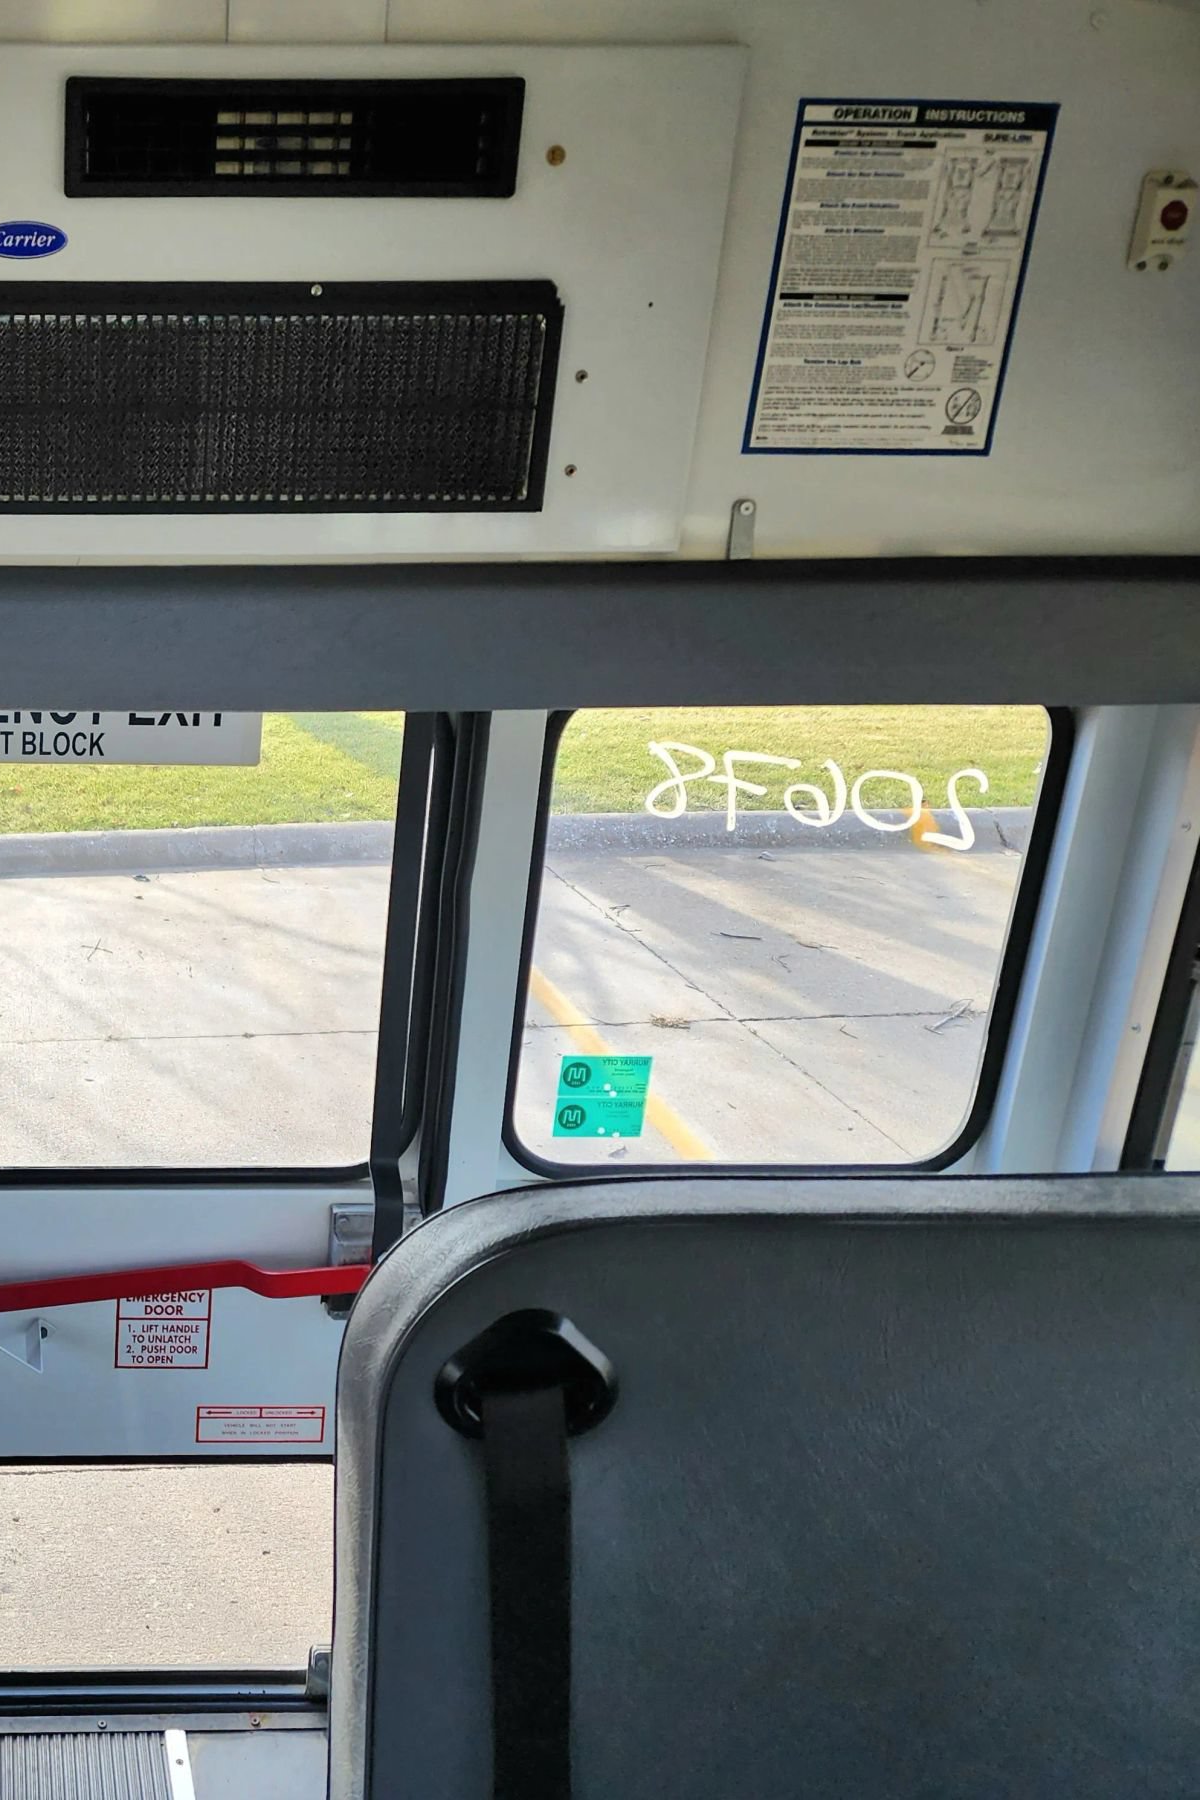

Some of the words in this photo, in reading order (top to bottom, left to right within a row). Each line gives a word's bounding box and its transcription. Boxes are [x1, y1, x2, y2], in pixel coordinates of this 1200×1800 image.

[833, 107, 913, 121] OPERATION
[925, 109, 1026, 123] INSTRUCTIONS
[21, 732, 105, 757] BLOCK
[144, 1304, 184, 1316] DOOR
[127, 1324, 136, 1334] 1.
[141, 1324, 159, 1334] LIFT
[162, 1324, 200, 1334] HANDLE
[132, 1335, 145, 1344] TO
[148, 1335, 191, 1344] UNLATCH
[126, 1345, 135, 1354] 2.
[141, 1345, 166, 1354] PUSH
[169, 1345, 198, 1355] DOOR
[131, 1355, 144, 1364] TO
[147, 1355, 174, 1364] OPEN
